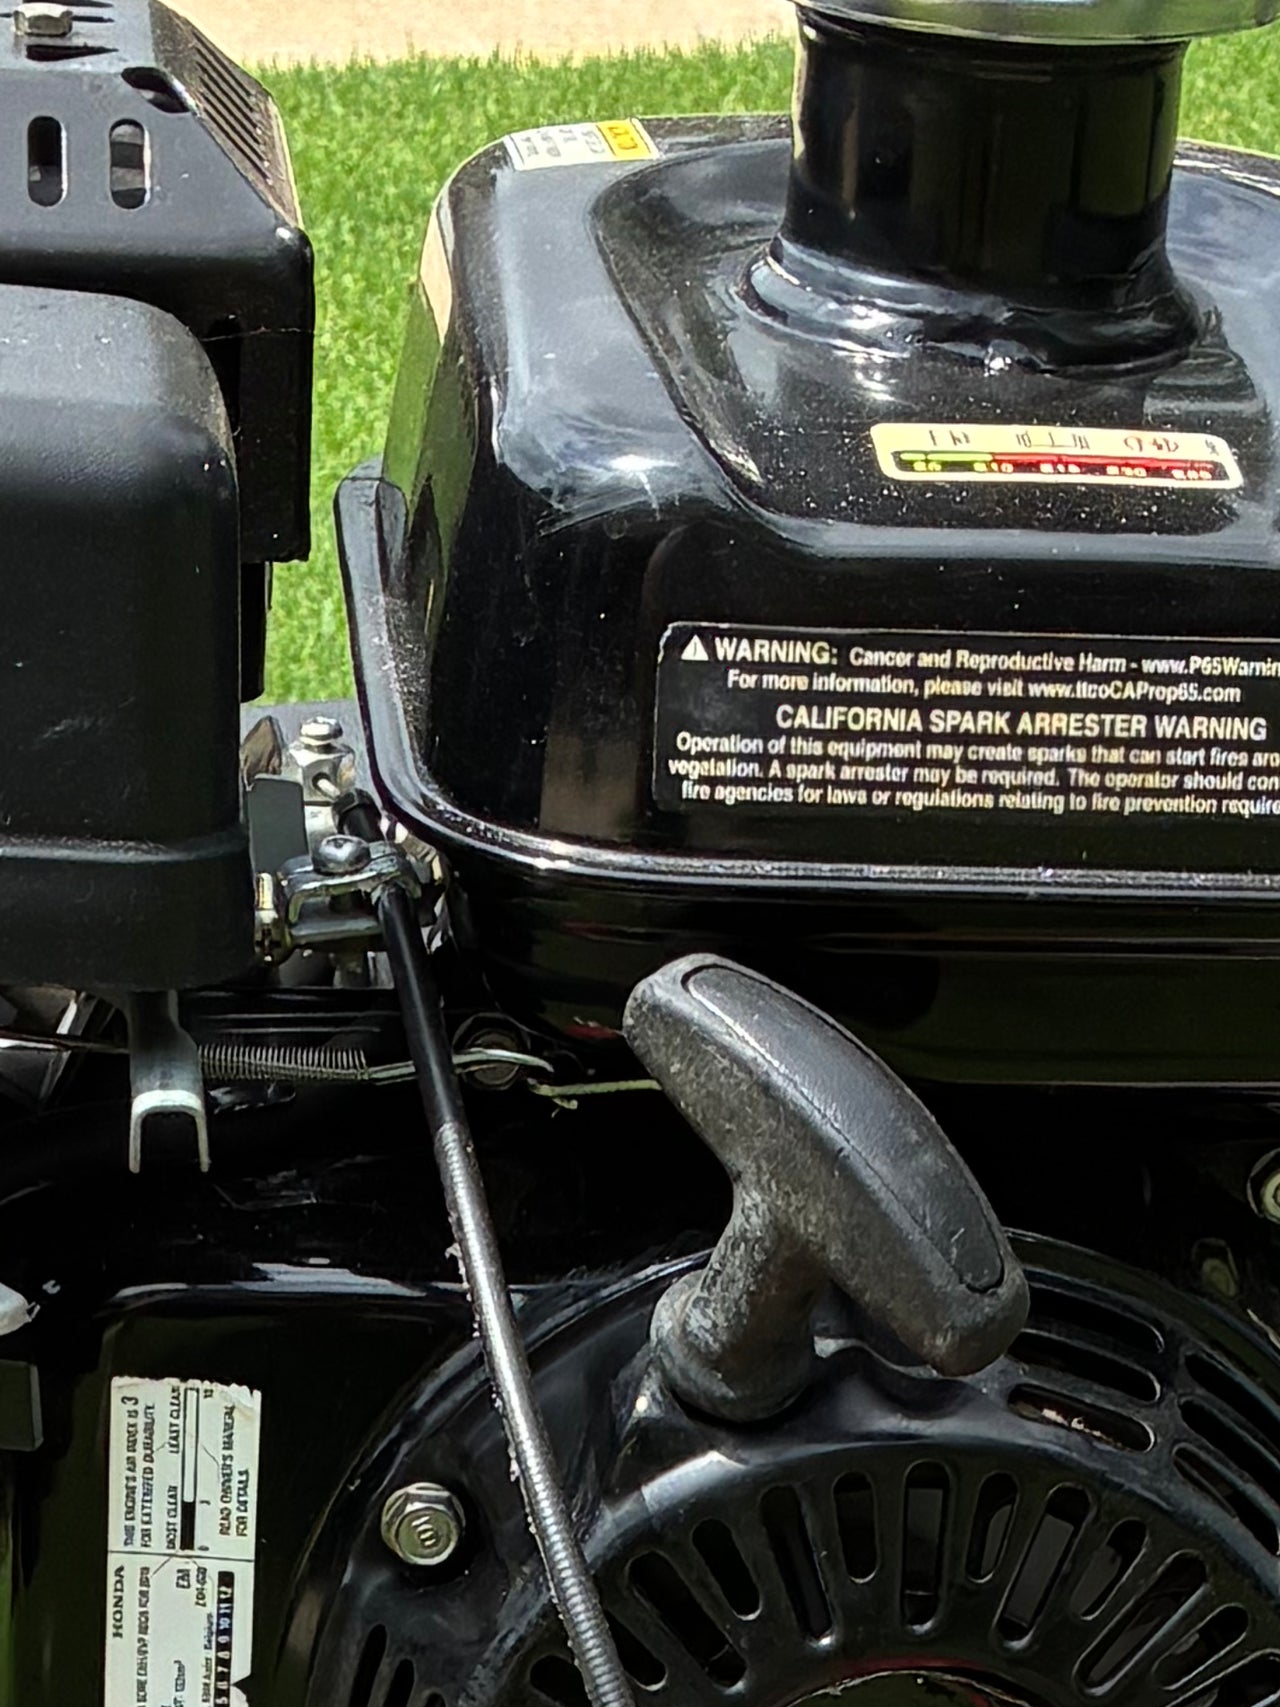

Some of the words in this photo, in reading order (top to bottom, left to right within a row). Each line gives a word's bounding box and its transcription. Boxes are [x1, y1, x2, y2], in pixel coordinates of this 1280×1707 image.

[715, 638, 838, 665] WARNING:
[849, 647, 914, 667] Cancer
[918, 649, 951, 668] and
[956, 650, 1074, 674] Reproductive
[1079, 653, 1126, 673] Harm
[728, 669, 758, 688] For
[762, 674, 809, 690] more
[813, 671, 919, 696] information,
[924, 677, 981, 699] please
[988, 676, 1023, 697] visit
[777, 705, 922, 732] CALIFORNIA
[929, 709, 1011, 734] SPARK
[1017, 712, 1147, 737] ARRESTER
[1155, 716, 1268, 741] WARNING
[677, 731, 763, 755] Operation
[768, 735, 786, 752] of
[790, 736, 822, 754] this
[828, 738, 922, 760] equipment
[926, 743, 964, 763] may
[968, 741, 1022, 759] create
[1028, 748, 1087, 767] sparks
[1091, 747, 1124, 765] that
[1129, 751, 1161, 765] can
[1166, 749, 1205, 767] start
[1210, 749, 1248, 767] fires
[669, 758, 763, 780] vegetation.
[769, 759, 782, 778] A
[786, 759, 835, 782] spark
[840, 762, 908, 782] arrester
[913, 766, 951, 787] may
[955, 765, 977, 784] be
[981, 766, 1060, 789] required.
[1067, 767, 1100, 787] The
[1105, 770, 1179, 791] operator
[1183, 772, 1243, 790] should
[682, 782, 710, 799] fire
[715, 785, 793, 805] agencies
[798, 786, 823, 803] for
[827, 787, 866, 804] laws
[872, 792, 890, 805] or
[895, 788, 994, 811] regulations
[998, 790, 1065, 814] relating
[1069, 792, 1087, 809] to
[1091, 793, 1120, 811] fire
[1124, 795, 1217, 816] prevention
[121, 1396, 138, 1406] 3
[112, 1565, 124, 1638] HONDA
